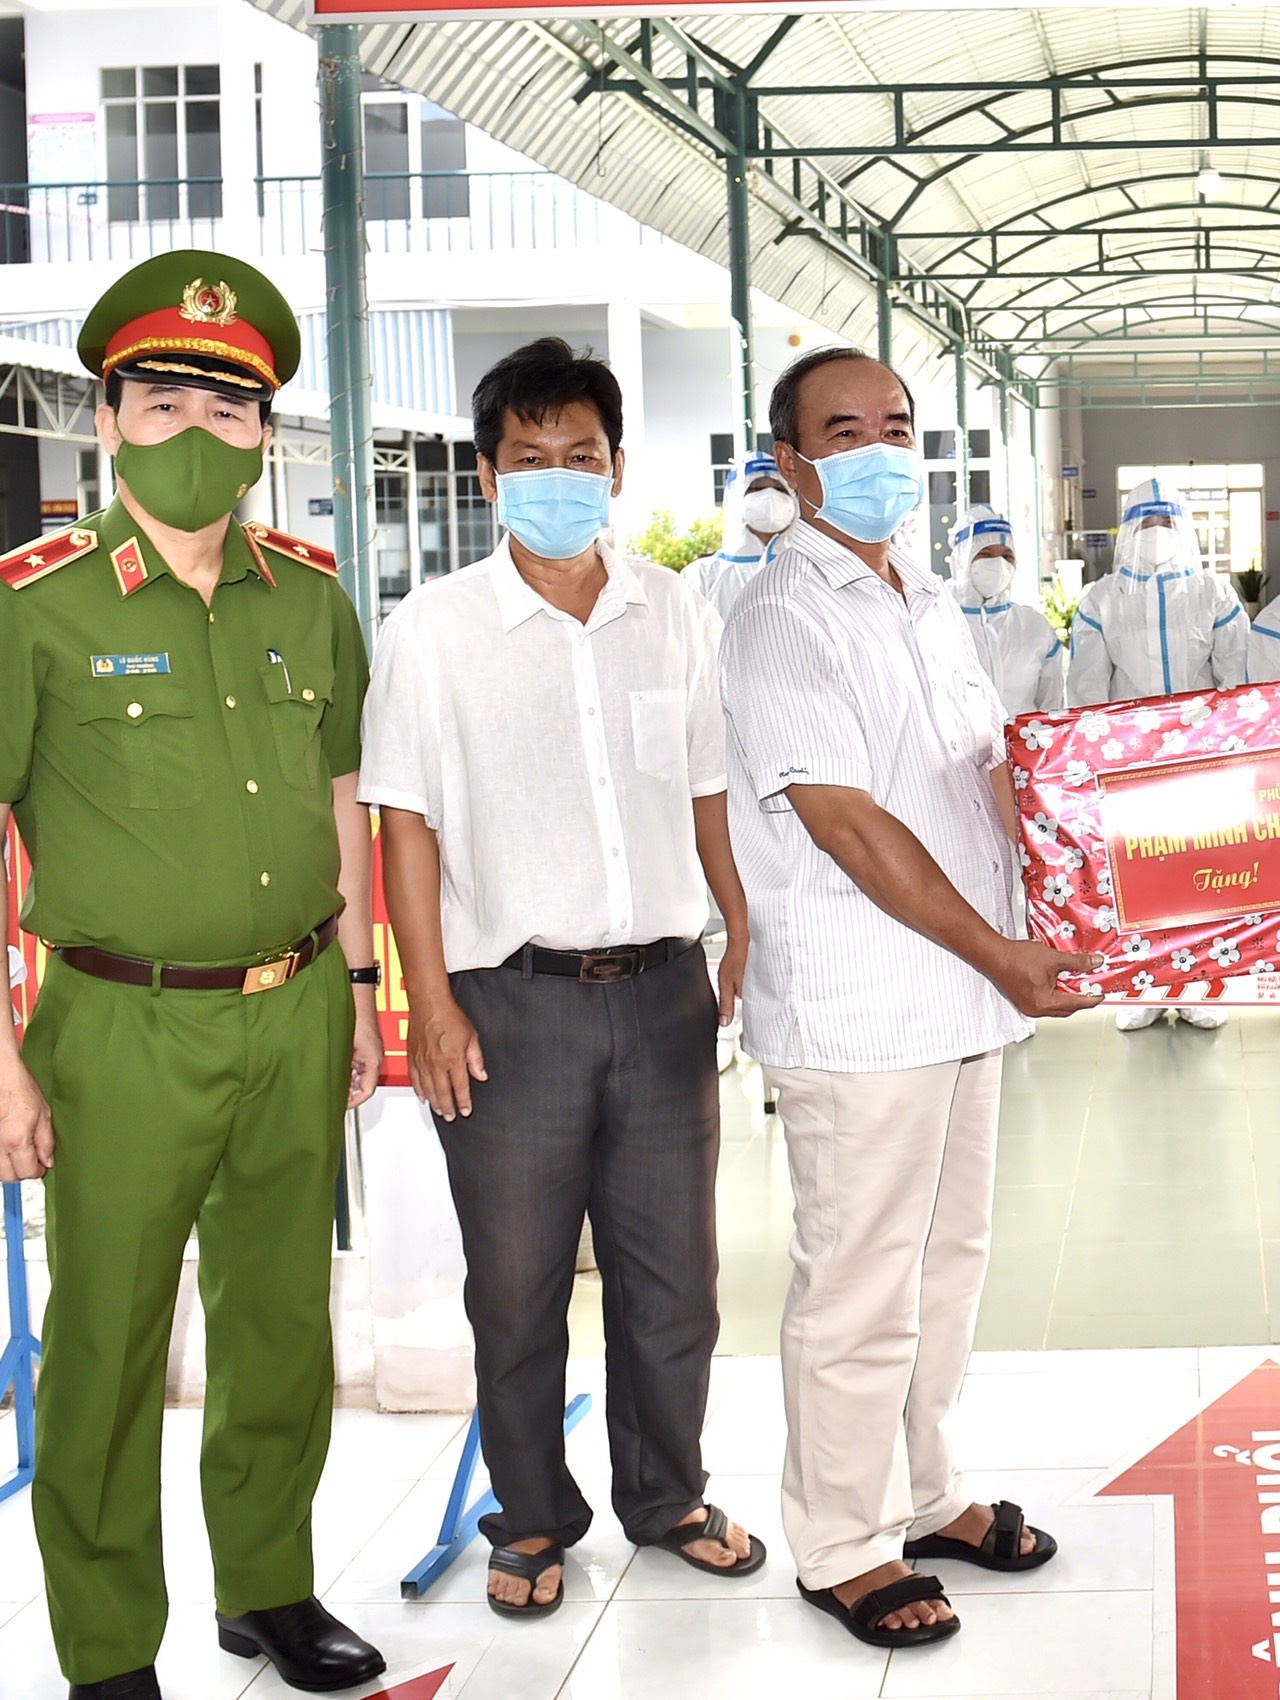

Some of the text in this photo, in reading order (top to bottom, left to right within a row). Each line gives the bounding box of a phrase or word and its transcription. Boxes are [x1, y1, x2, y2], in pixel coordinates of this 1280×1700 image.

[1124, 832, 1188, 862] PHẠM
[1193, 819, 1249, 851] MINH
[1192, 861, 1261, 894] Tặng!
